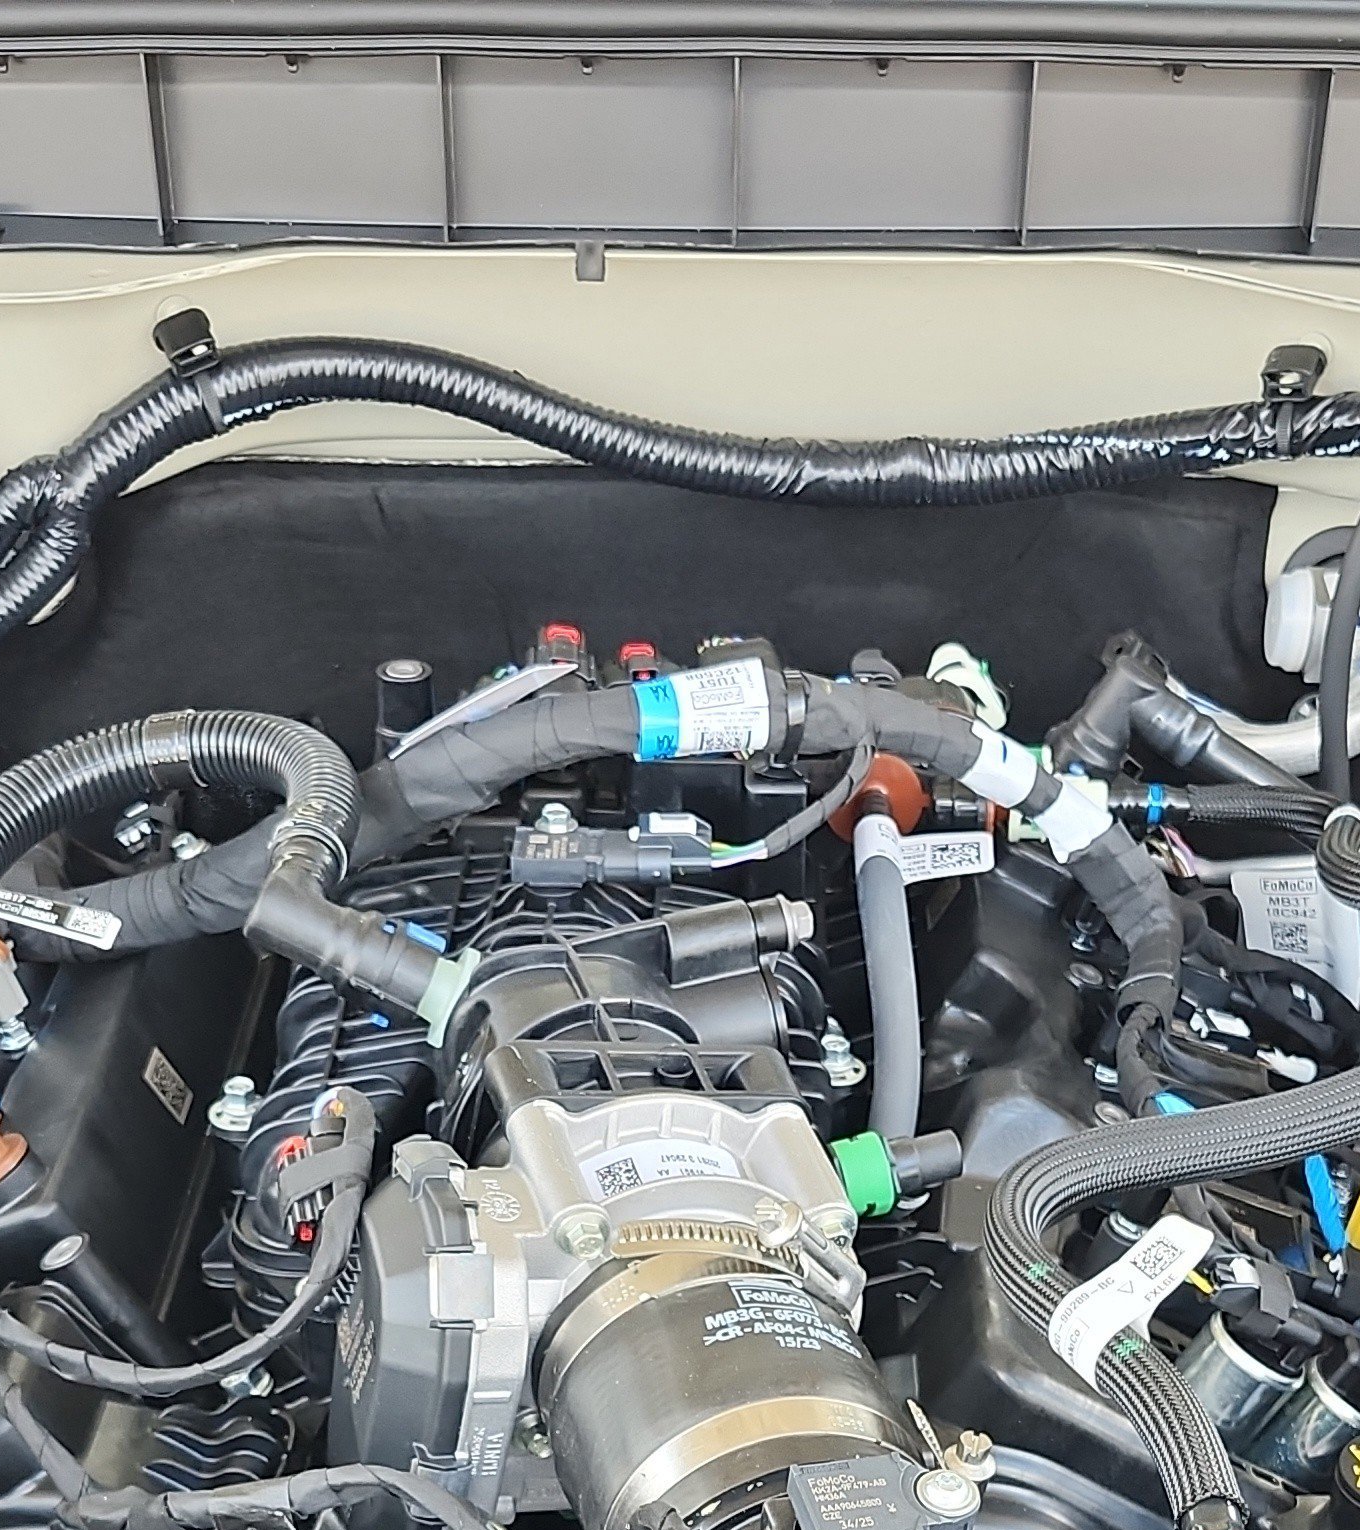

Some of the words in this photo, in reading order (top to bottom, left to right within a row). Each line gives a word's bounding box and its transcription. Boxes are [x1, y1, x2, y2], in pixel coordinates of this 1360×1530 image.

[1262, 879, 1313, 892] FoMoCo
[1269, 896, 1311, 907] MB3T
[742, 1290, 811, 1309] FoMoCo
[808, 1475, 856, 1487] FoMoCo
[838, 1517, 876, 1530] 34/25
